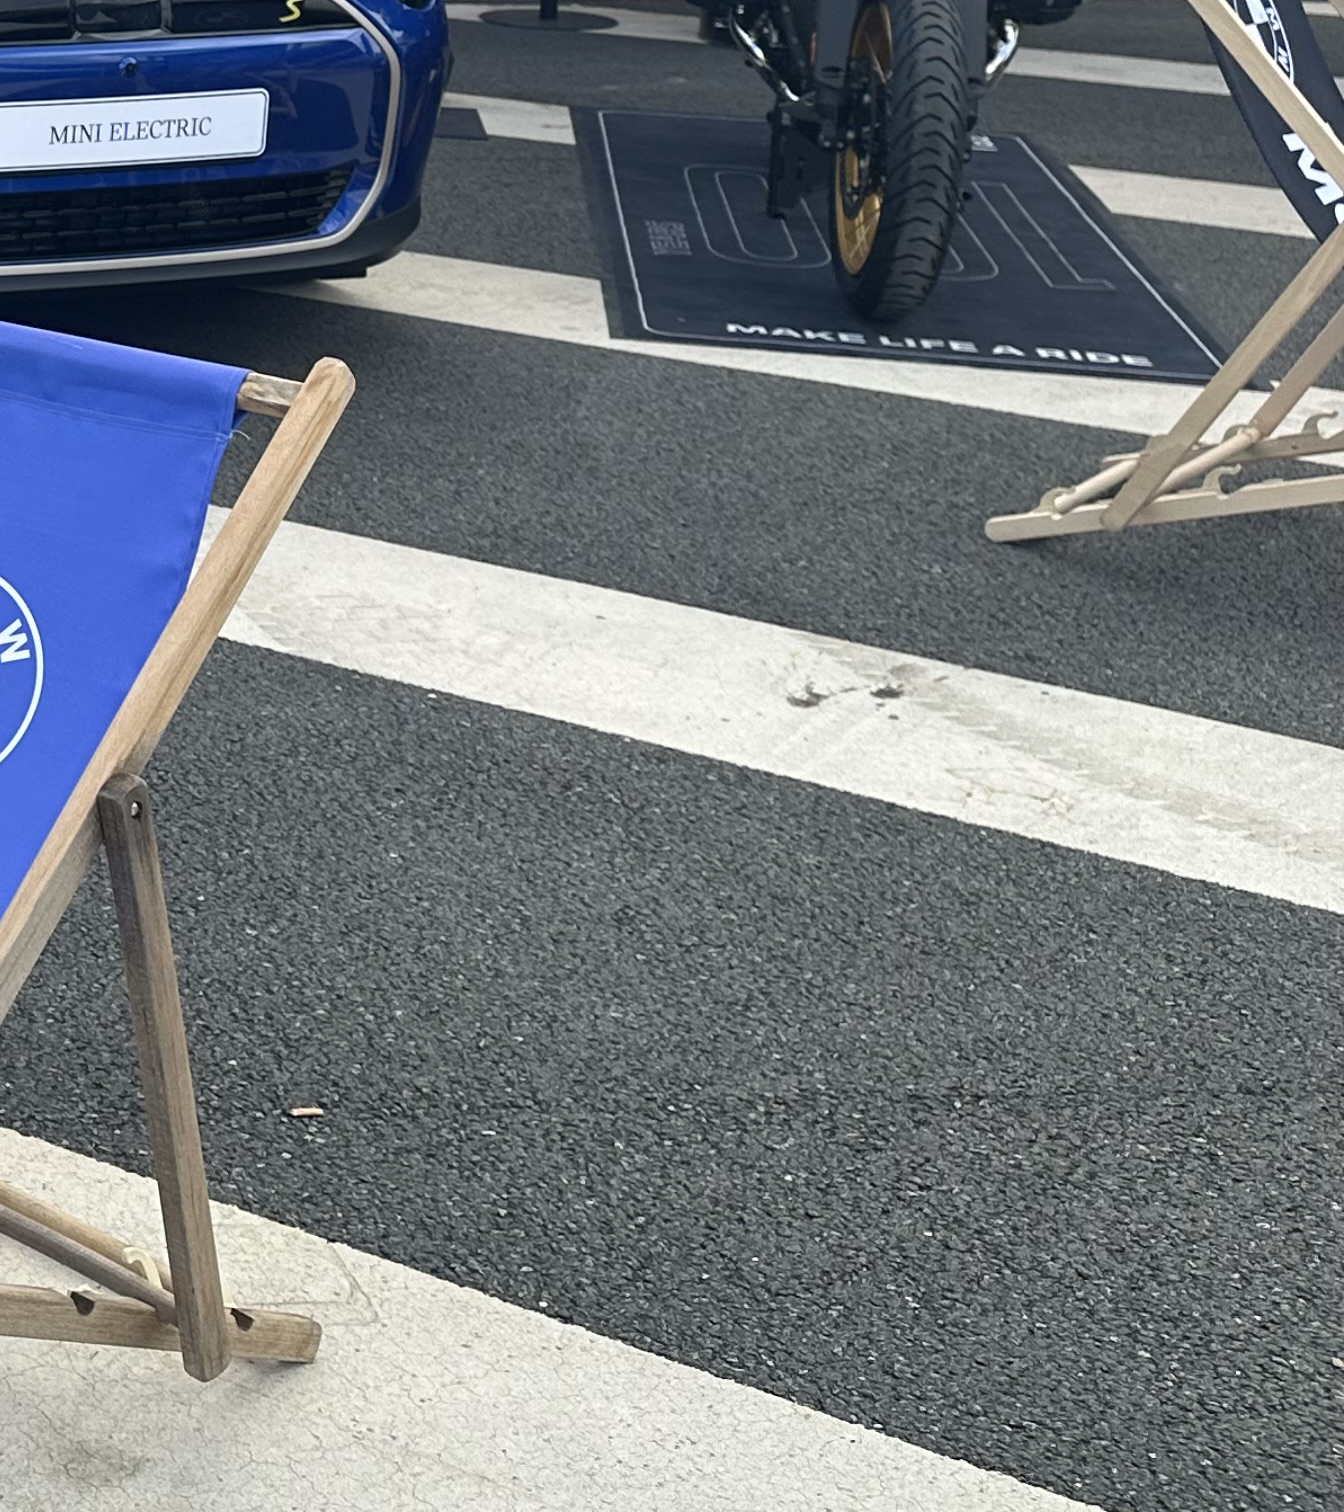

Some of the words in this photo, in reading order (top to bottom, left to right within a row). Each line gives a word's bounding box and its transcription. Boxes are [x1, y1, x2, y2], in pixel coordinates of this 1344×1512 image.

[48, 123, 103, 145] MINI
[108, 116, 213, 143] ELECTRIC
[725, 321, 866, 346] MAKE
[879, 334, 980, 354] LIFE
[992, 344, 1026, 358] A
[1034, 346, 1155, 368] RIDE
